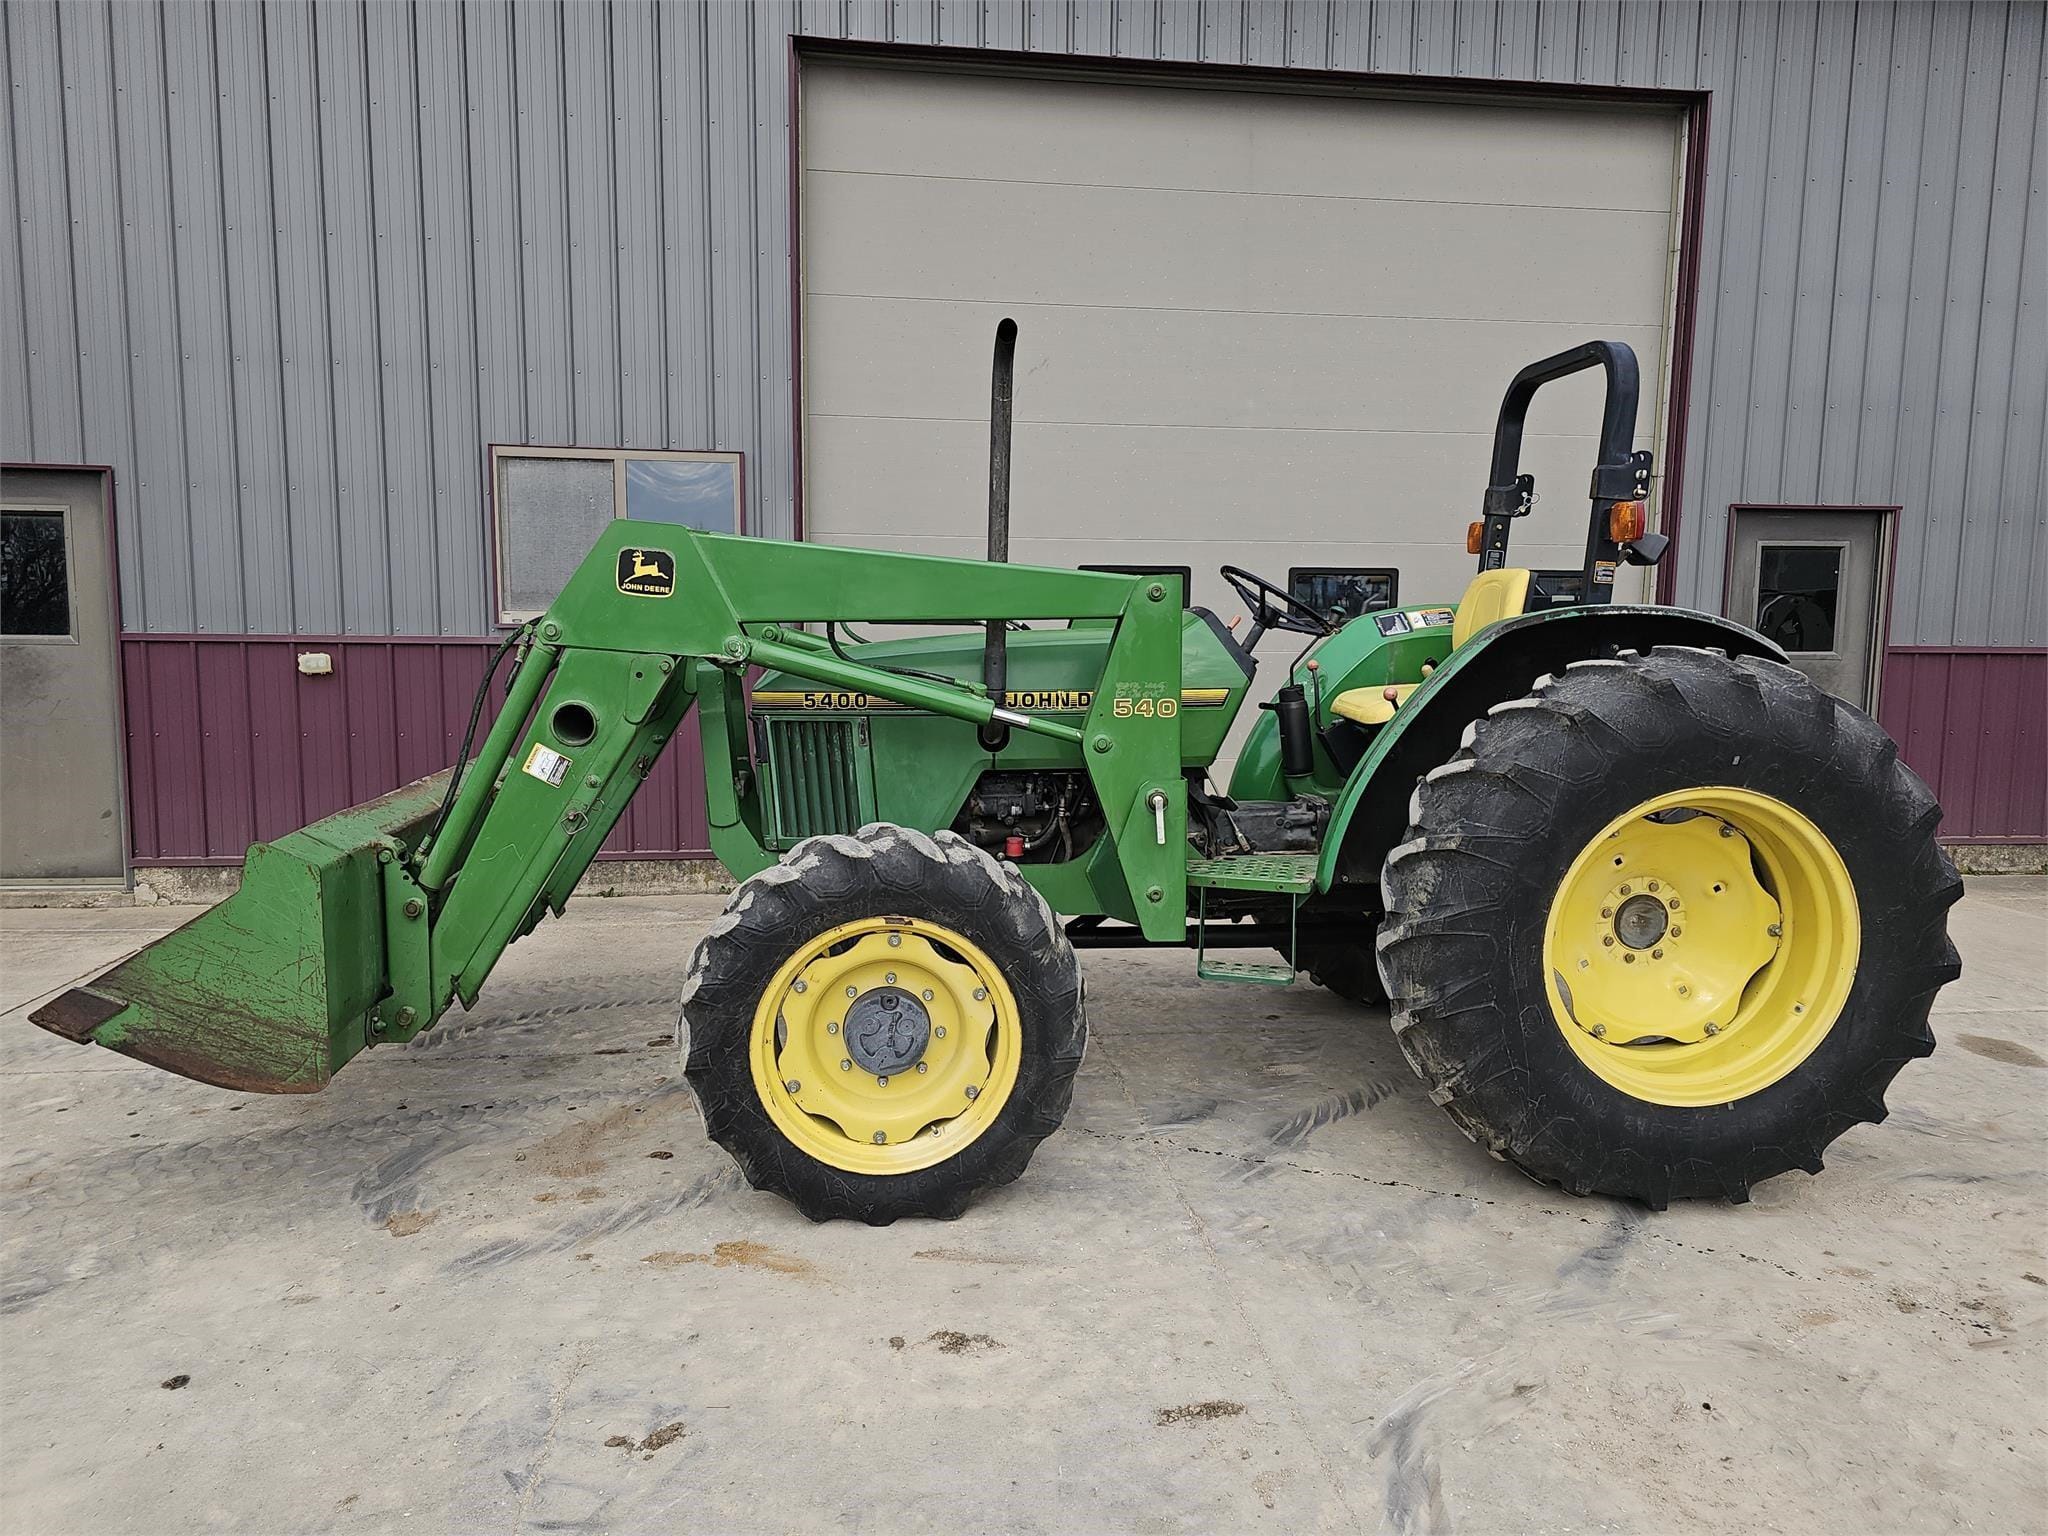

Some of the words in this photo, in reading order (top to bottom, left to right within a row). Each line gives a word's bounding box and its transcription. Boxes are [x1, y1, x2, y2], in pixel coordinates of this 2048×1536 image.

[621, 583, 643, 591] JOHN
[644, 585, 670, 593] DEERE
[804, 693, 868, 709] 5400
[1006, 691, 1070, 708] JOHN
[1113, 698, 1177, 718] 540
